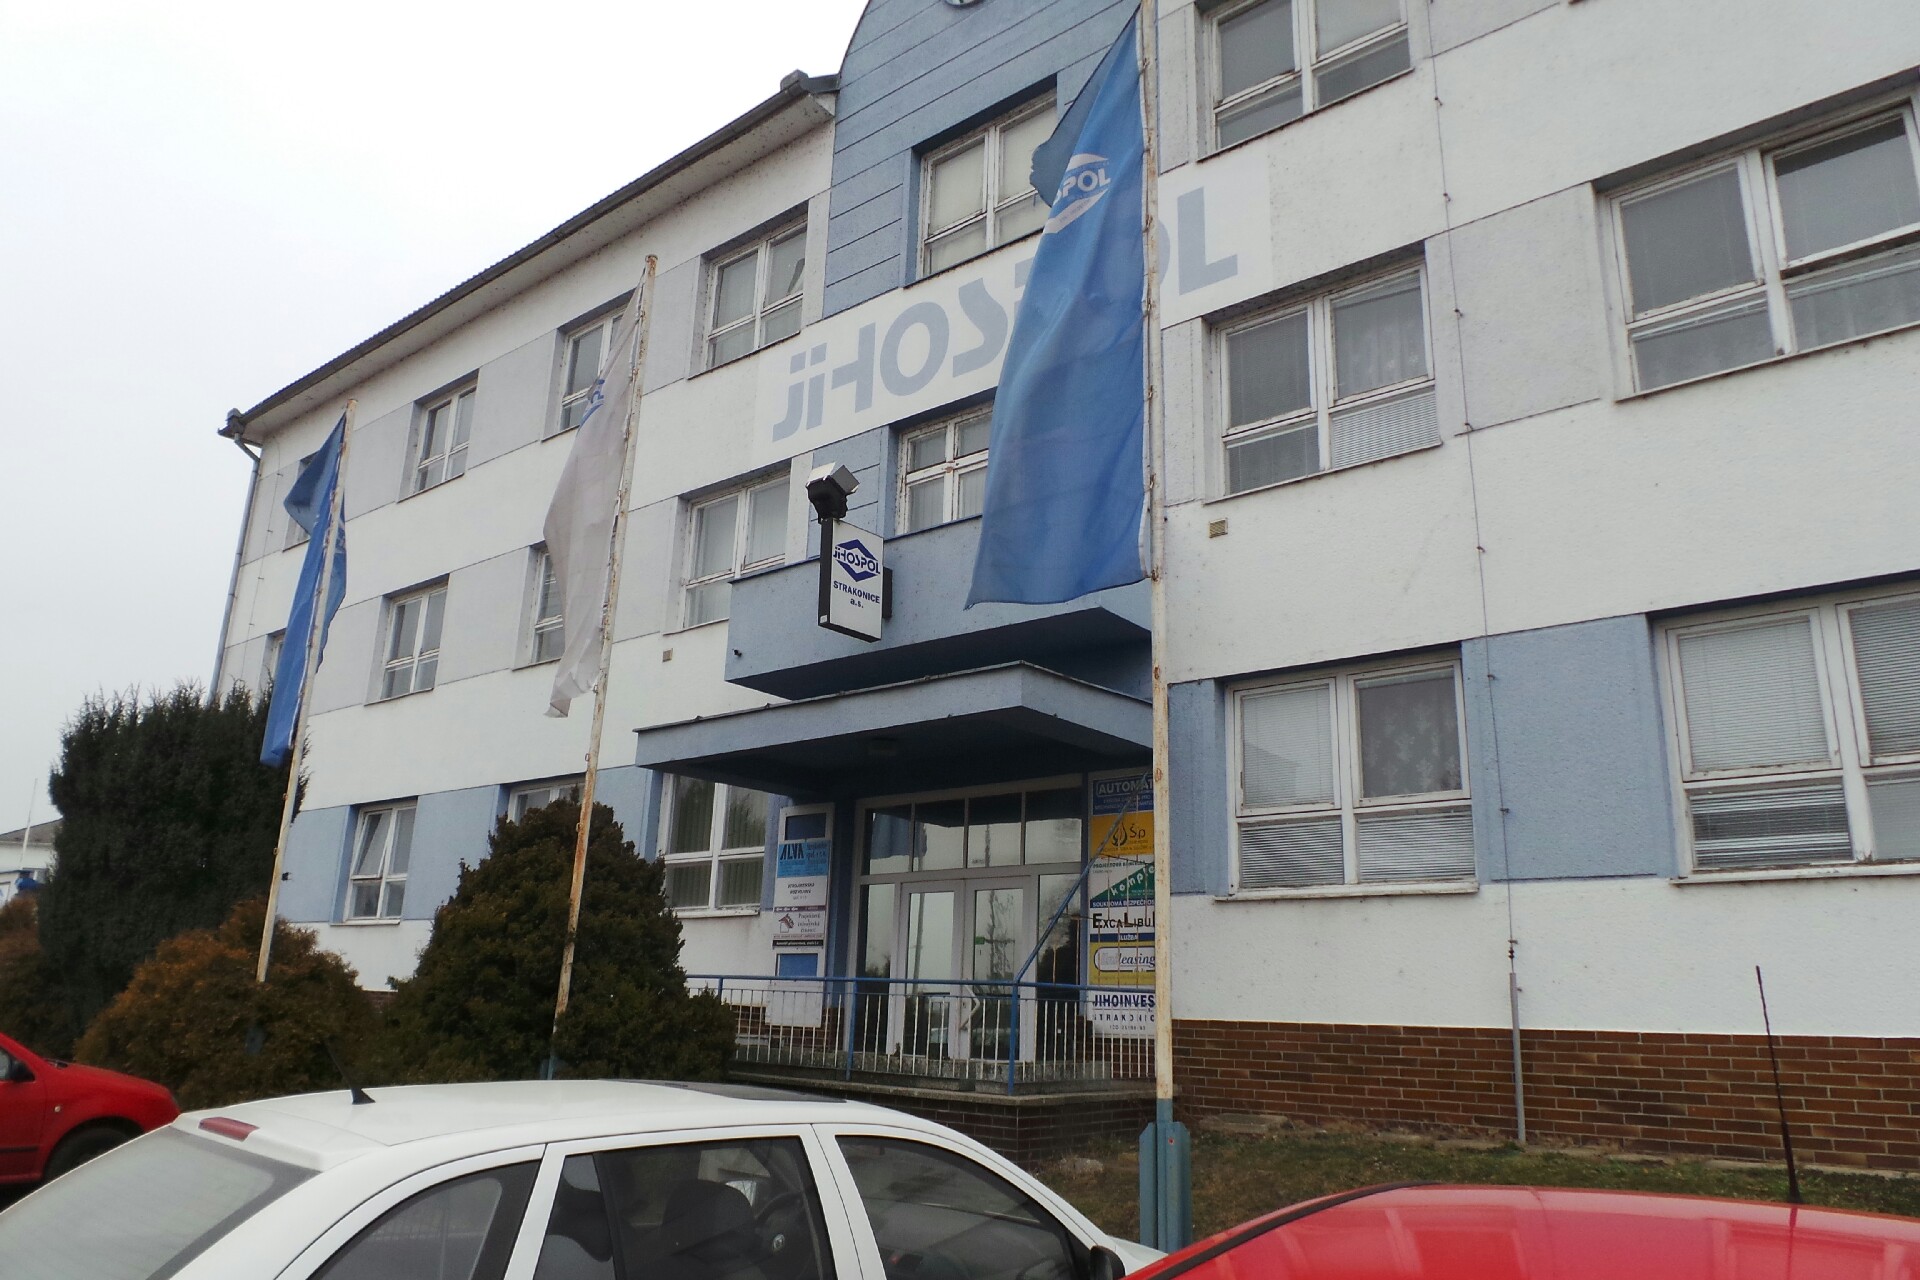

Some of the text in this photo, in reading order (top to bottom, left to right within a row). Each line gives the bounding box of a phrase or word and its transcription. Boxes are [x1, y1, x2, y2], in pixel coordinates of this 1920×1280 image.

[832, 580, 881, 604] STRAKONICE
[849, 597, 864, 609] a.s.
[779, 842, 804, 861] ALVA
